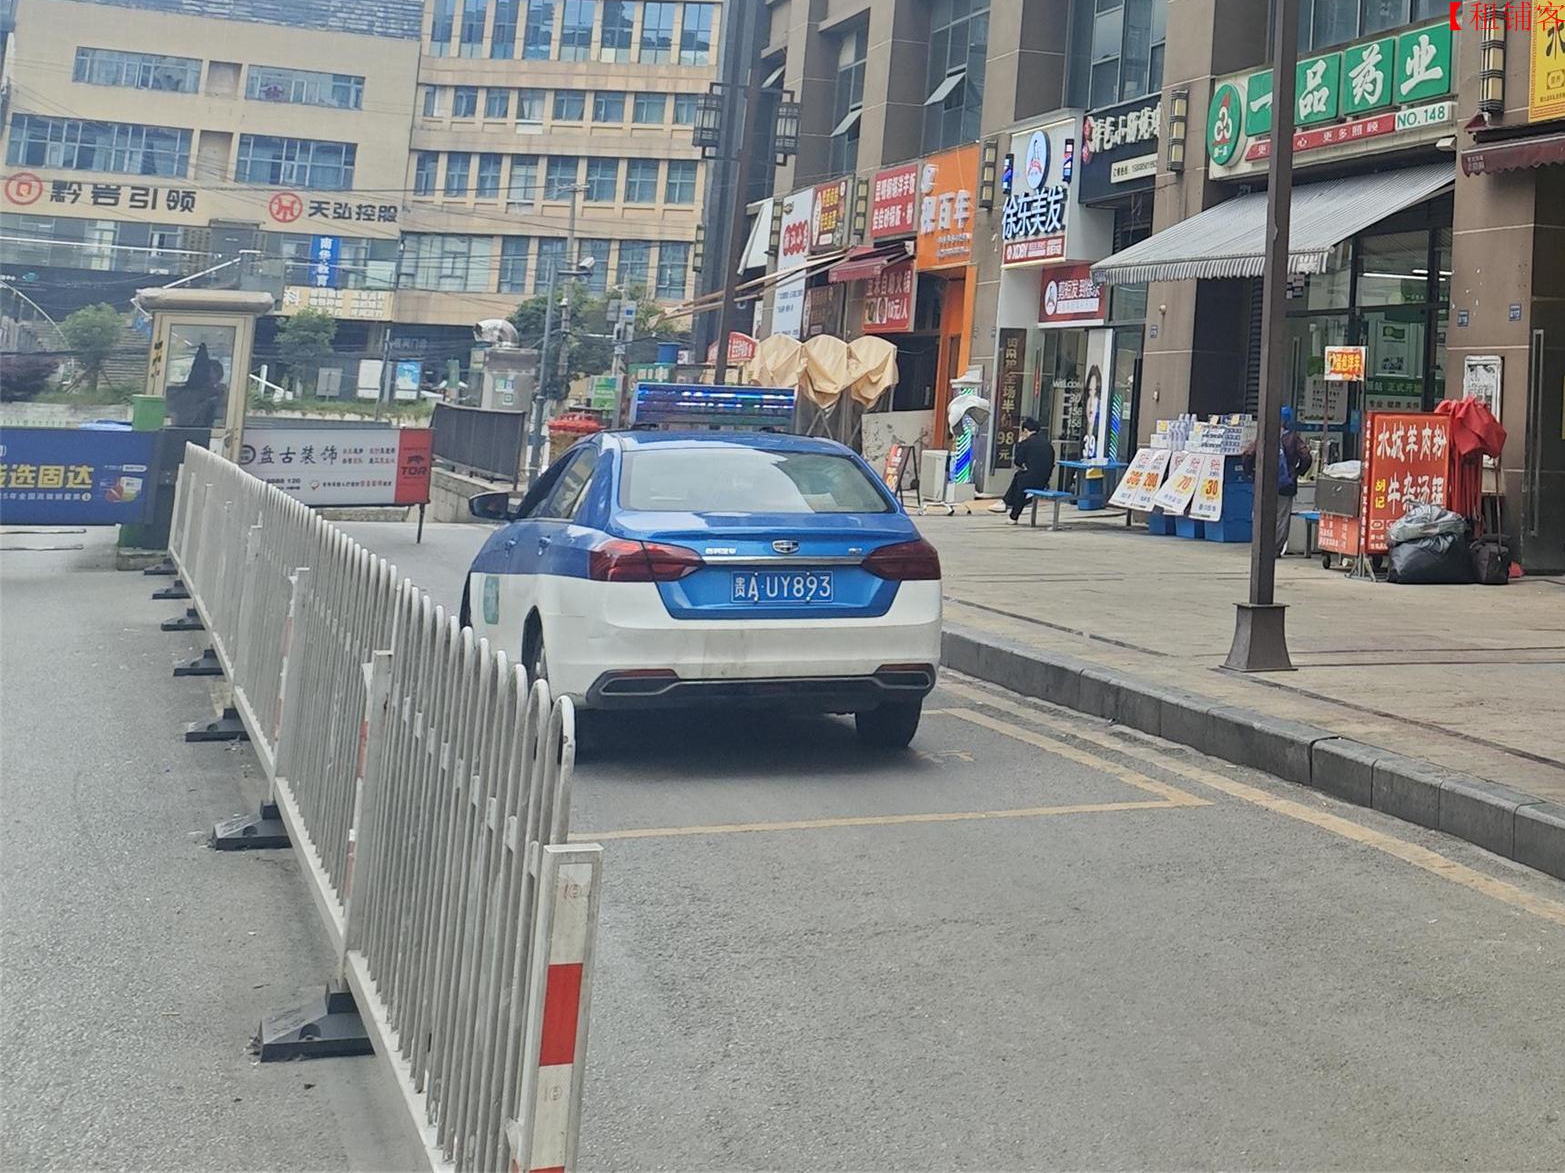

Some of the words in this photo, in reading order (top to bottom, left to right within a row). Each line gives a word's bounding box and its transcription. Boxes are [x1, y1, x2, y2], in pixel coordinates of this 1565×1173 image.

[308, 199, 399, 223] 天弘控股
[1002, 185, 1065, 240] 徐东美发
[1083, 435, 1096, 456] 39
[1376, 420, 1447, 464] 水城羊肉粉
[257, 444, 339, 466] 盘古装饰
